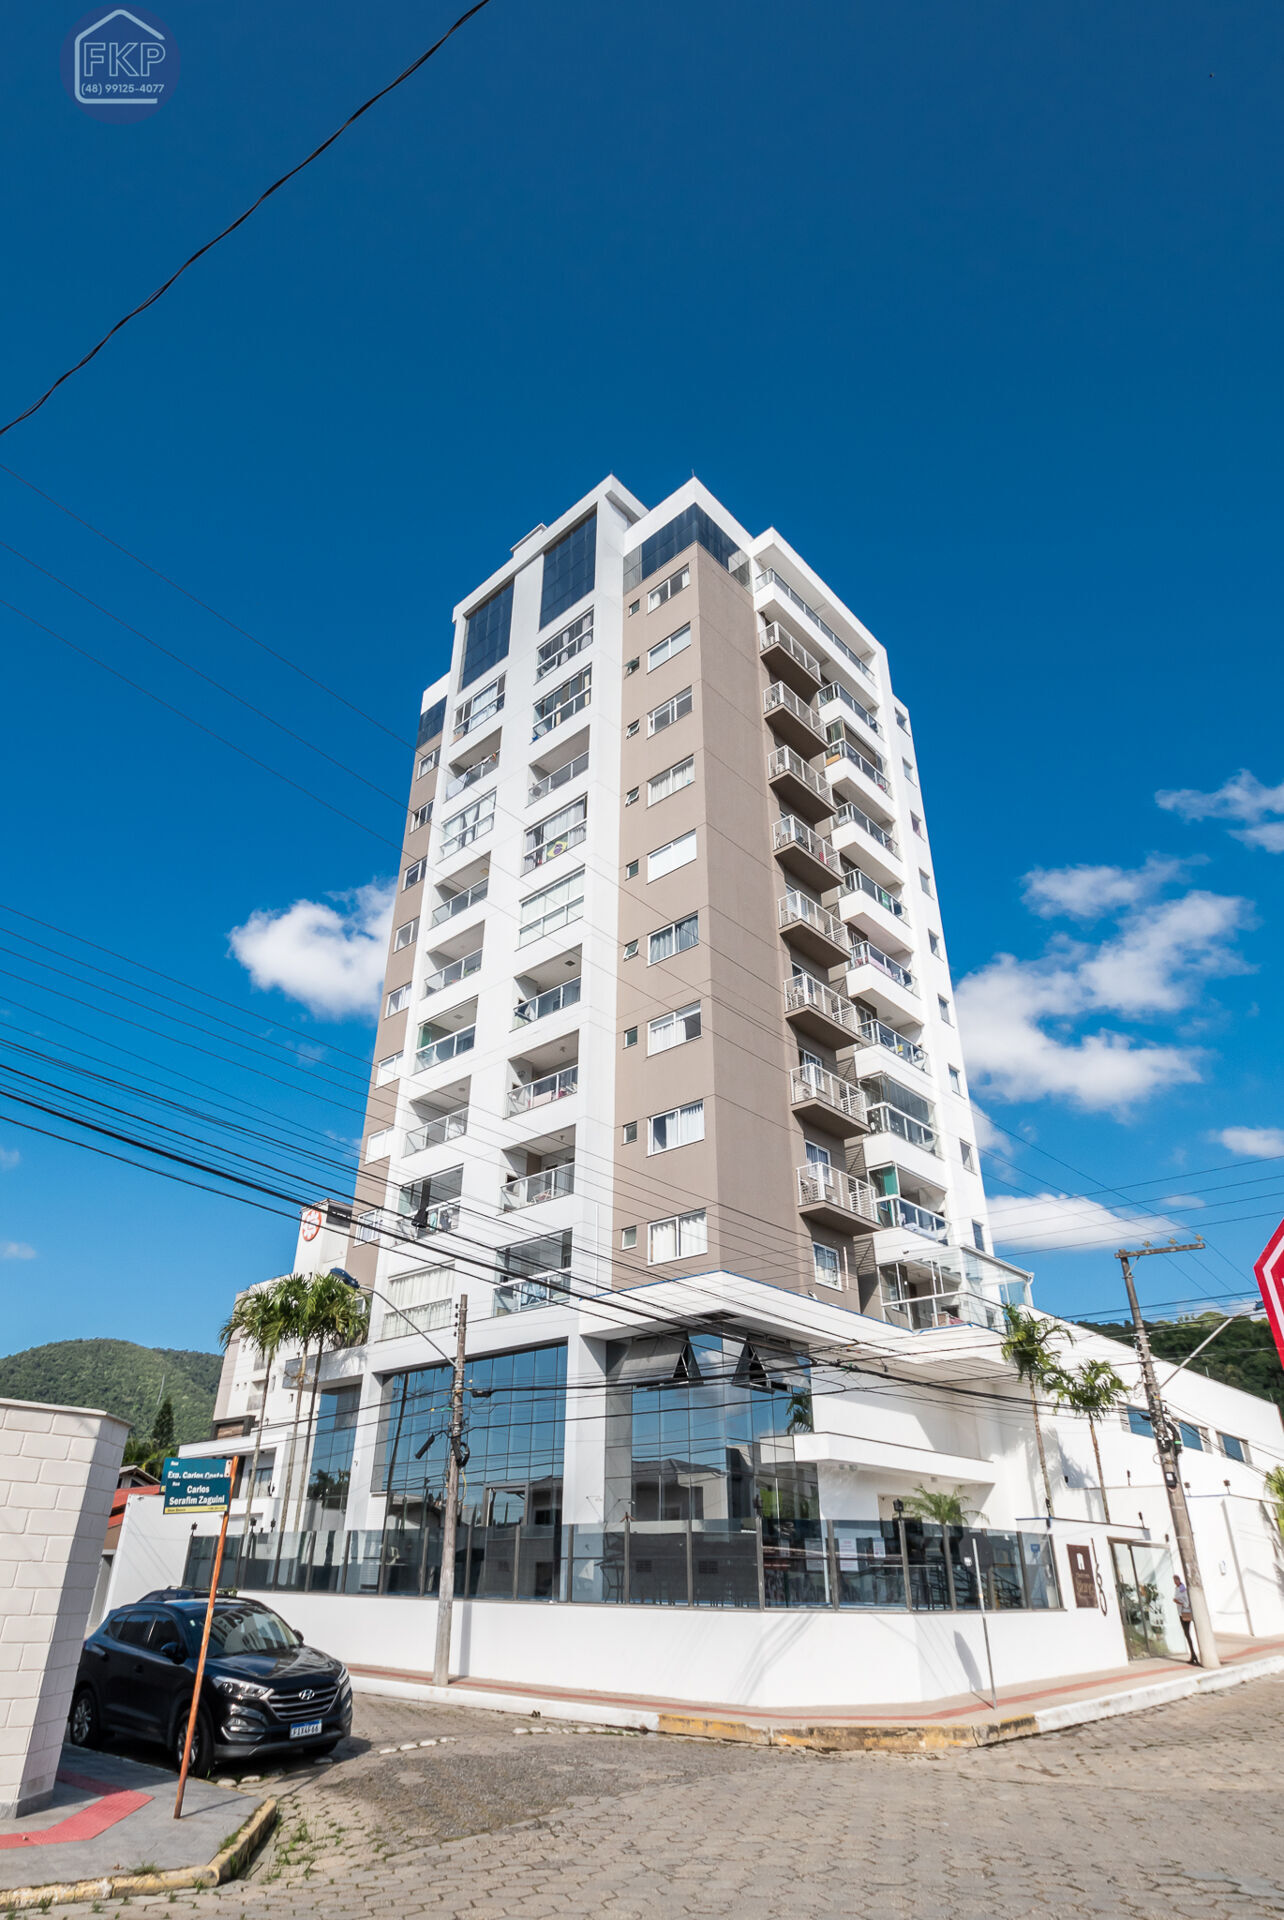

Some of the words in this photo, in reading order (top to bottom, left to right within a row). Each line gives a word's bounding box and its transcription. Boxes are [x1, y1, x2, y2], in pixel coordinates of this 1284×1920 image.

[182, 1471, 204, 1479] Carlos
[186, 1485, 210, 1494] Carlos
[169, 1496, 198, 1505] Serafim
